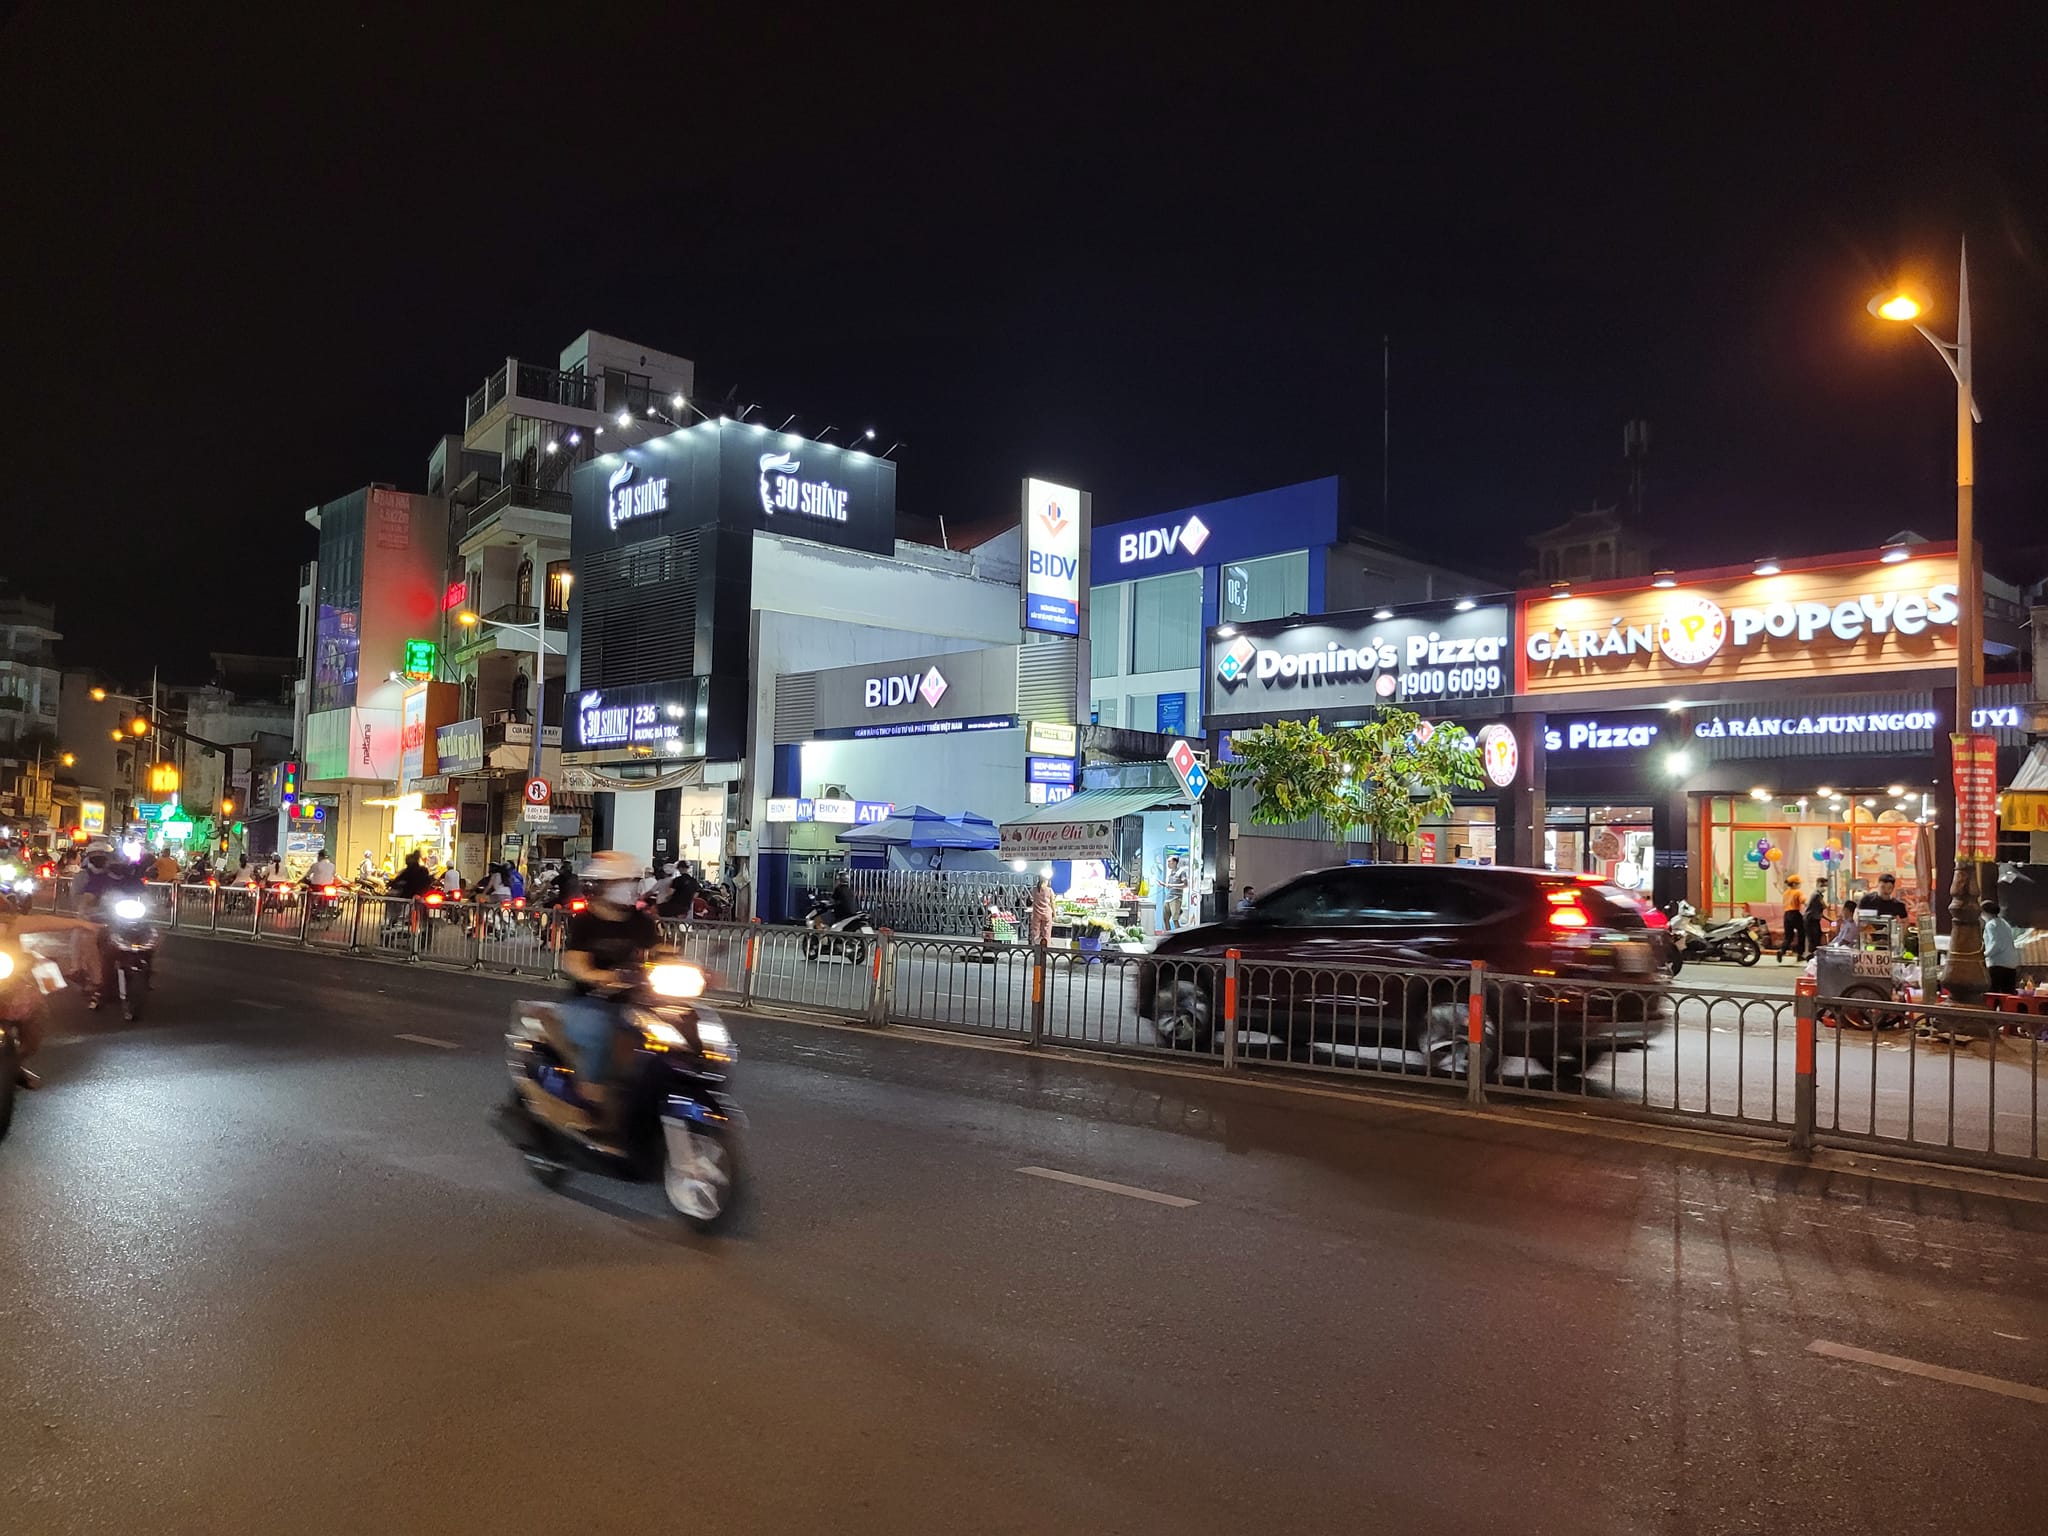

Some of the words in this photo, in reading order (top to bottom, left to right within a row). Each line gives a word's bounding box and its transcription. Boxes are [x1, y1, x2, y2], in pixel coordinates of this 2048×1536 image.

[617, 487, 633, 520] 30
[633, 477, 667, 516] SHINE
[775, 475, 798, 510] 30
[800, 481, 848, 521] SHINE
[1119, 525, 1181, 563] BIDV
[1029, 550, 1078, 580] BIDV
[1256, 636, 1398, 679] Domino's
[1406, 631, 1500, 666] Pizza
[864, 674, 921, 708] BIDV
[1400, 670, 1445, 696] 1900
[1447, 666, 1500, 692] 6099
[587, 710, 600, 737] 30
[601, 707, 629, 736] SHINE
[635, 705, 656, 724] 236
[1782, 715, 1867, 735] CAJUN
[1569, 721, 1650, 749] Pizza
[819, 803, 839, 813] BIDV
[858, 805, 890, 822] ATM
[1852, 951, 1873, 965] BÚN
